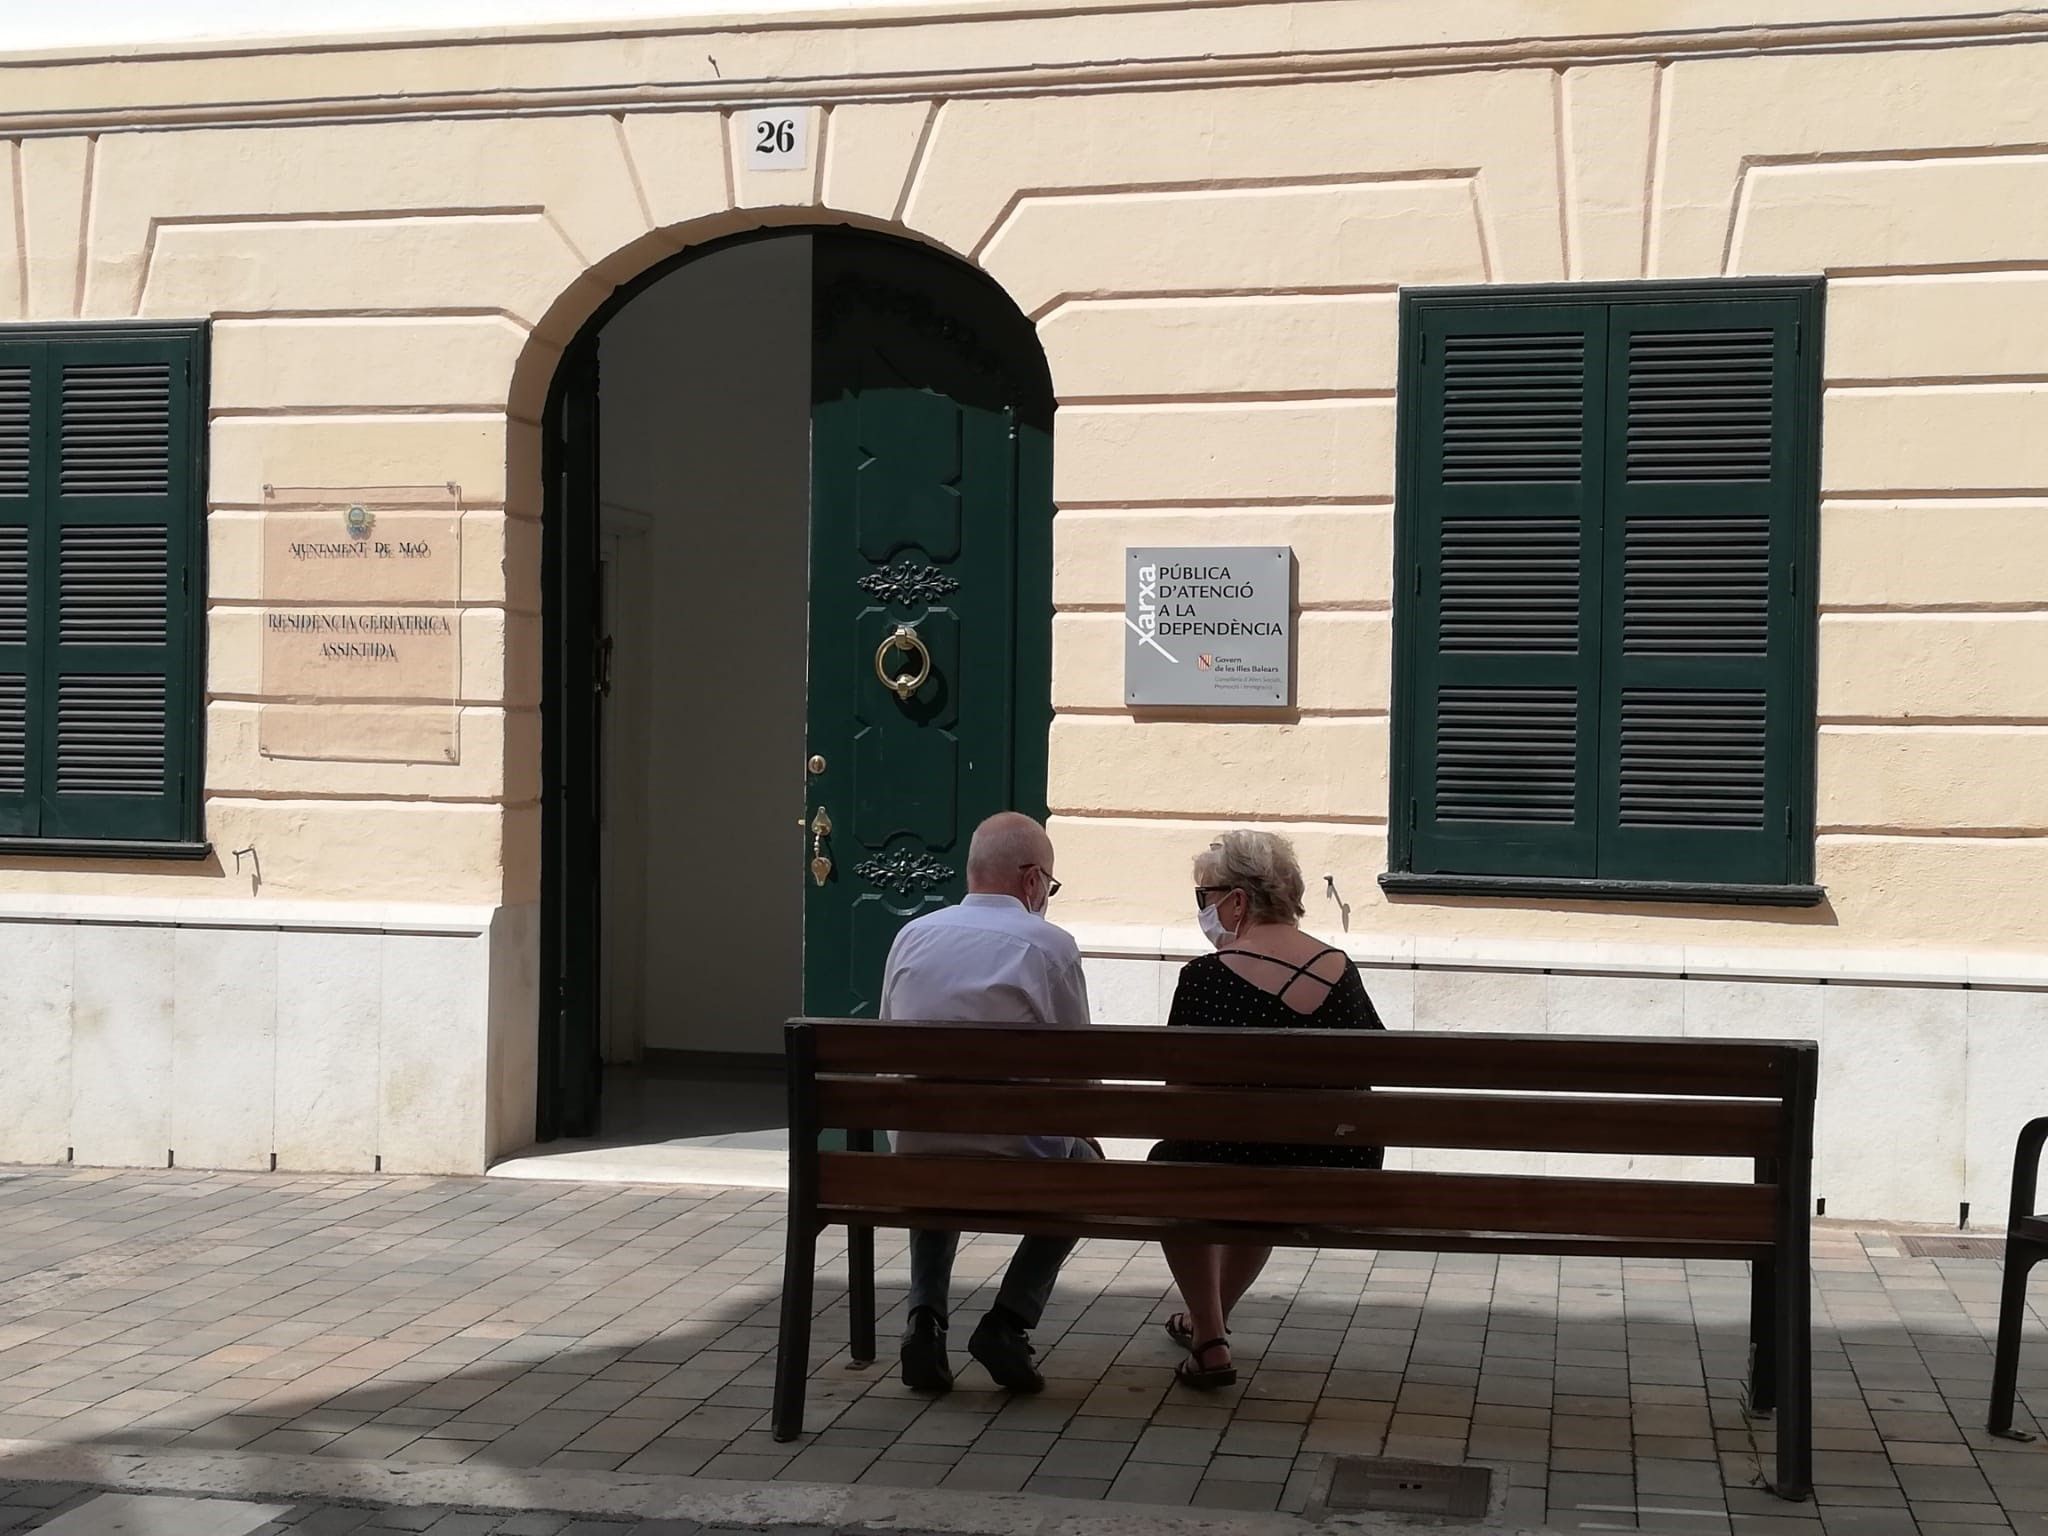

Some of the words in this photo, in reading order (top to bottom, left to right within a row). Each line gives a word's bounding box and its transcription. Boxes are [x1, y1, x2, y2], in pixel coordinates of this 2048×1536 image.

[756, 119, 795, 154] 26
[288, 542, 367, 556] AJUNTAMENT
[375, 542, 391, 554] DE
[1159, 563, 1232, 580] PÚBLICA
[1159, 581, 1254, 598] D'ATENCIÓ
[1158, 604, 1170, 617] A
[1175, 604, 1196, 617] LA
[1159, 618, 1283, 635] DEPENDÈNCIA
[319, 642, 397, 658] ASSISTIDA
[1215, 656, 1242, 664] Govern
[1214, 665, 1224, 673] de
[1225, 665, 1235, 673] les
[1236, 665, 1251, 673] Illes
[1252, 665, 1279, 673] Balears
